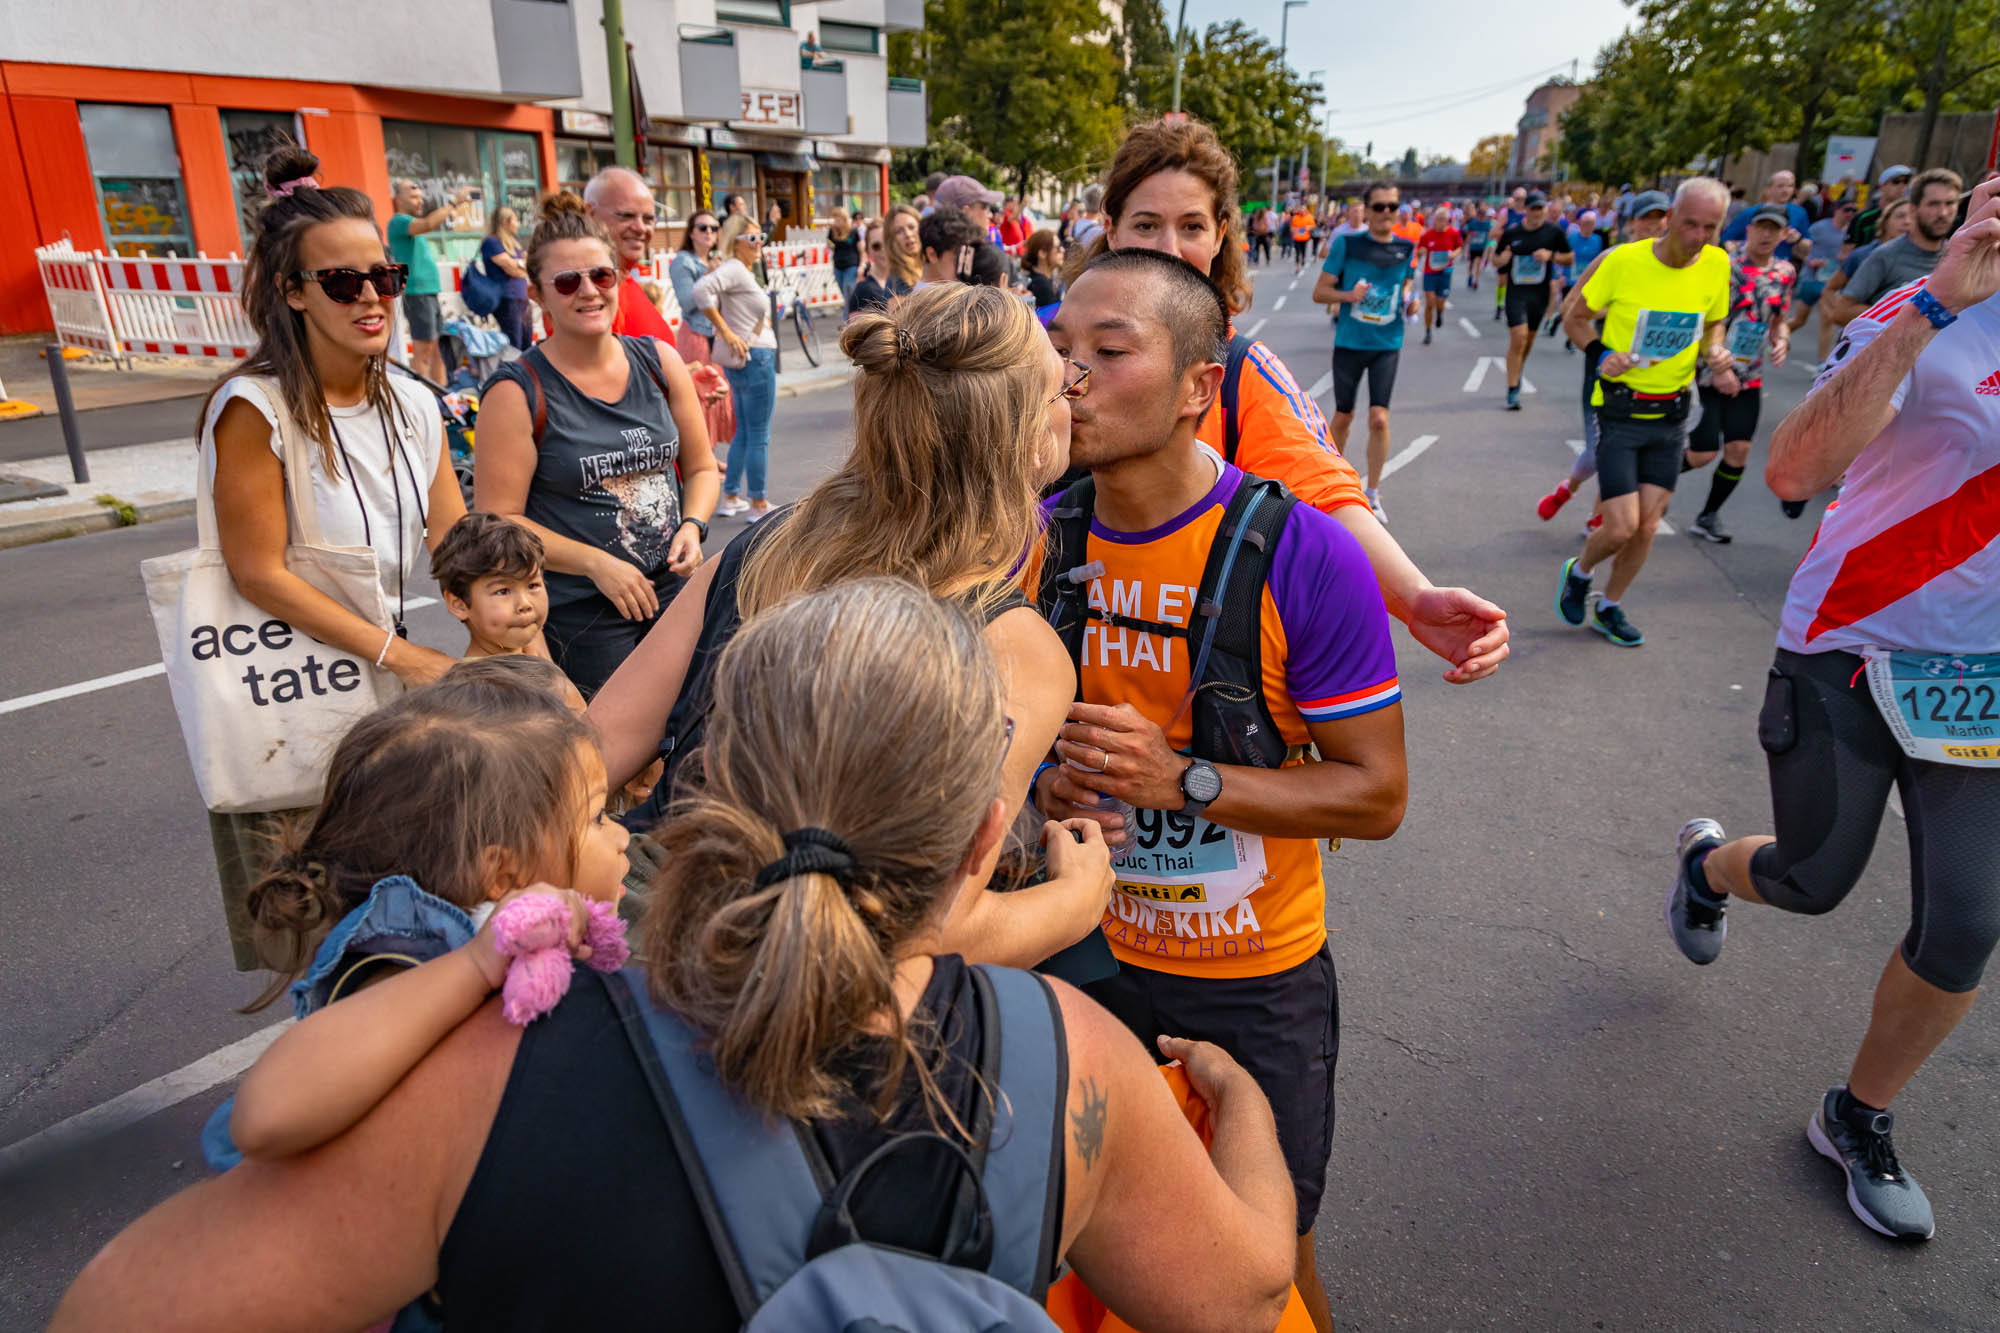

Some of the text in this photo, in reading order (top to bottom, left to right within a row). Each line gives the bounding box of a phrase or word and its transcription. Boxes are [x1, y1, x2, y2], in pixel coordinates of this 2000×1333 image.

[620, 426, 652, 453] THE
[190, 619, 293, 661] ace
[1081, 625, 1172, 673] THAI
[241, 655, 361, 707] tate
[1944, 724, 1995, 737] Martin
[1947, 747, 1989, 758] Giti
[1151, 851, 1195, 872] Thai
[1121, 884, 1171, 901] Giti
[1173, 897, 1262, 939] KIKA
